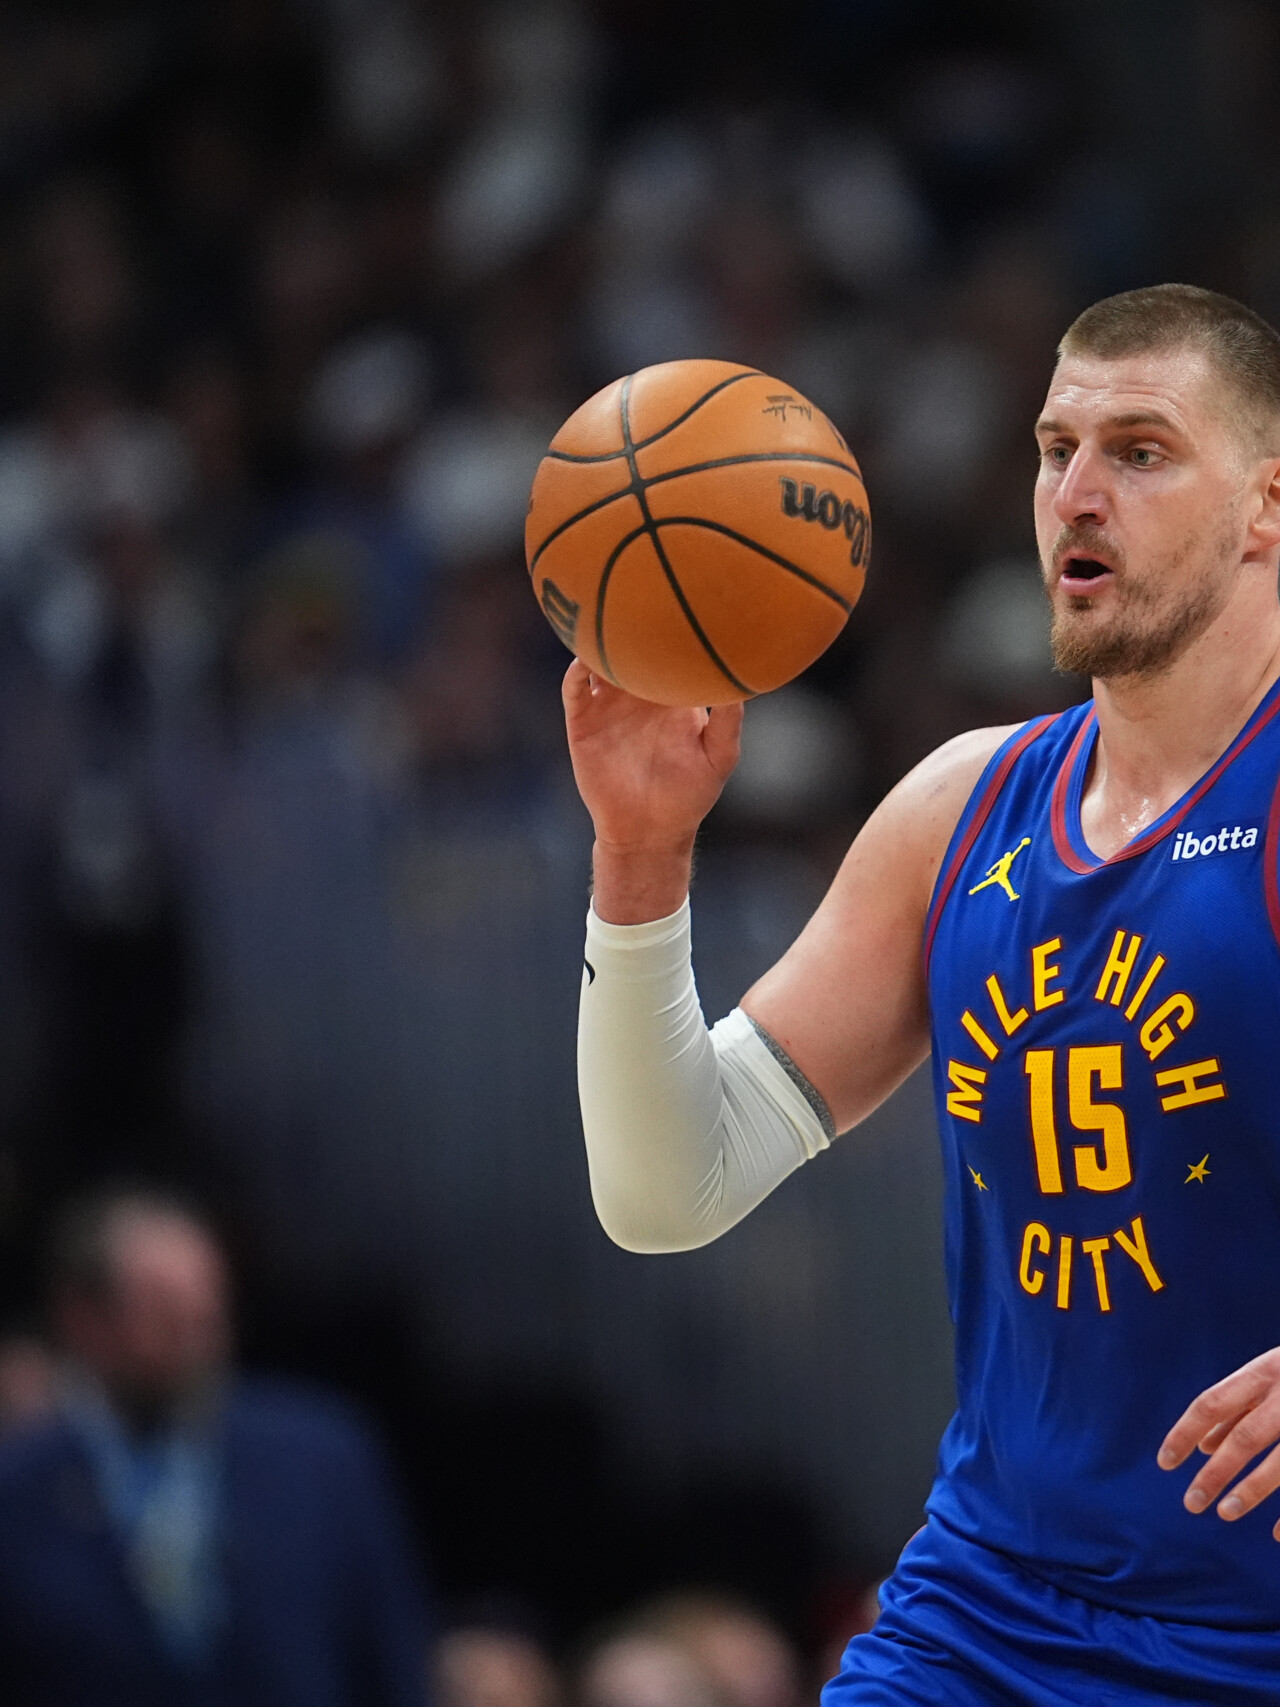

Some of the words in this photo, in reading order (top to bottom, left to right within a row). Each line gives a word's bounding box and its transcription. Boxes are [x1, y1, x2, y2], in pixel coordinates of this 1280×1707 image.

[1172, 826, 1258, 860] ibotta
[946, 936, 1064, 1122] MILE
[1094, 930, 1227, 1113] HIGH
[1024, 1044, 1132, 1194] 15
[1019, 1215, 1165, 1312] CITY
